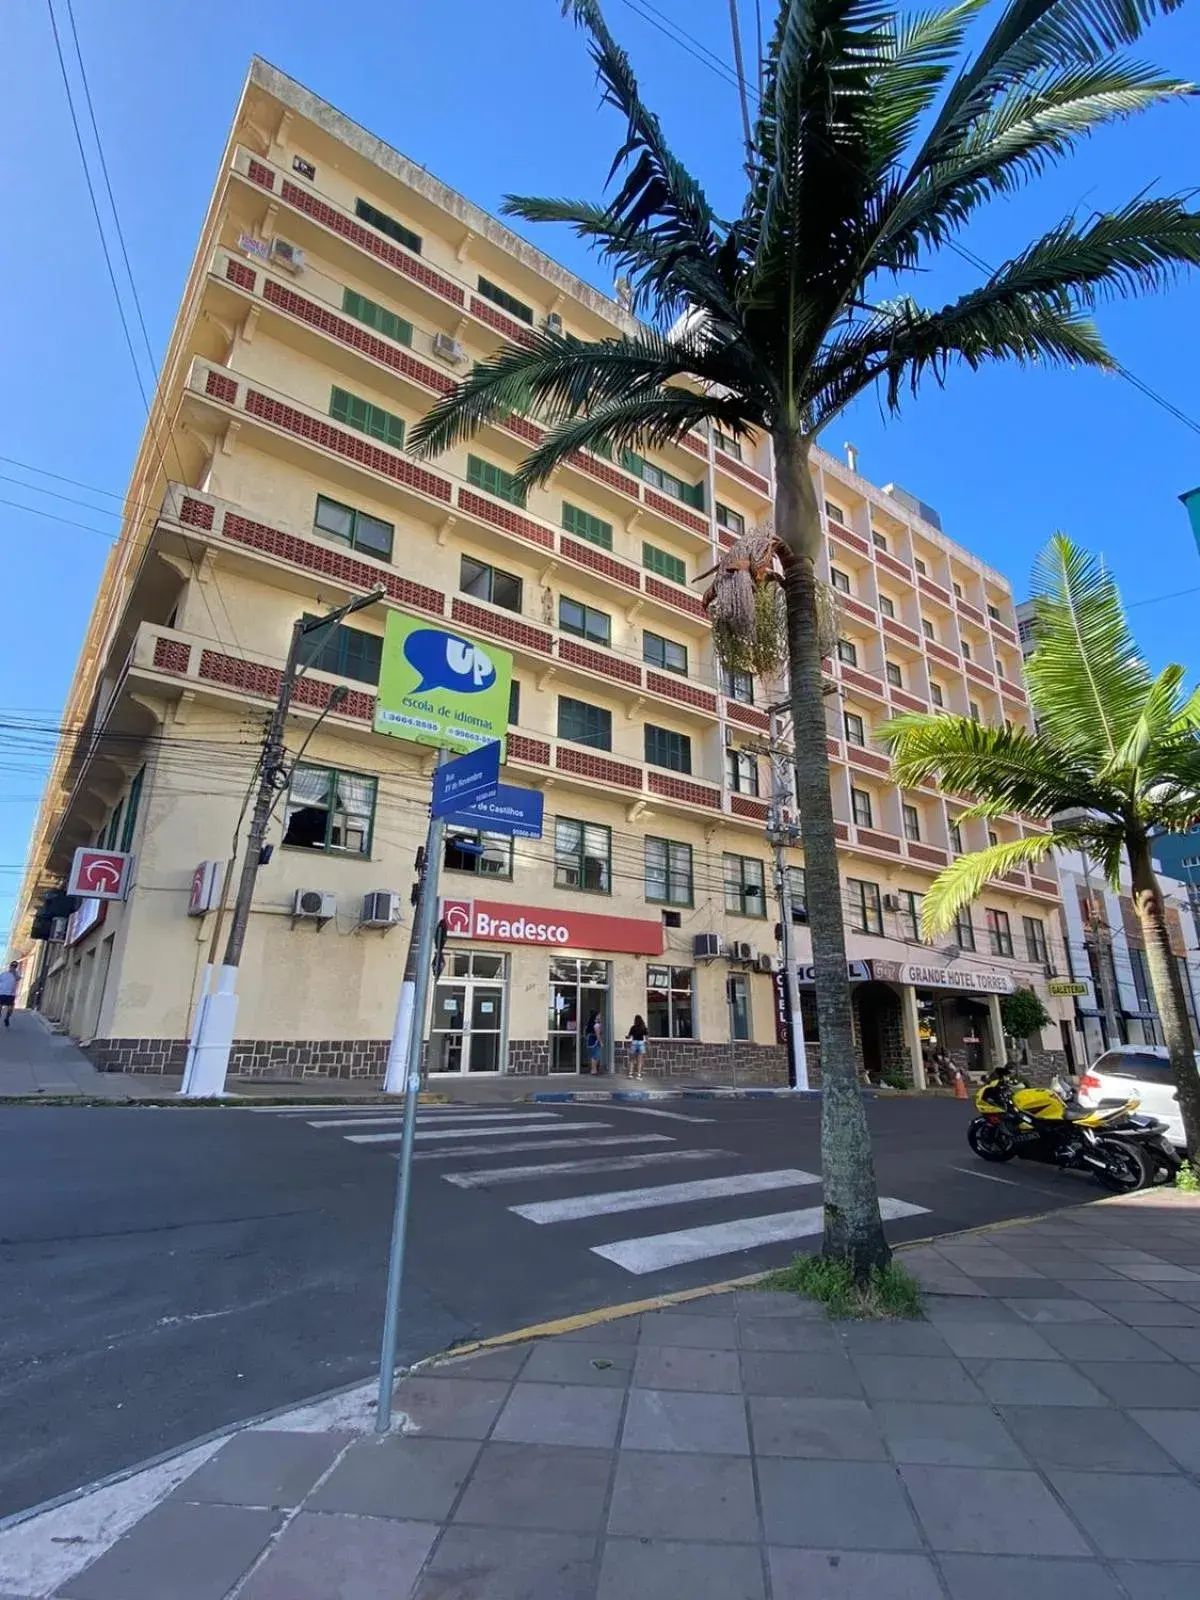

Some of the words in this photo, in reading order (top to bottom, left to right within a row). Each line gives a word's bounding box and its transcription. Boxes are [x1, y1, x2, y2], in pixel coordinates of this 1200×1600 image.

[402, 697, 433, 713] escola
[438, 706, 451, 718] de
[454, 711, 493, 730] idiomas
[478, 802, 487, 811] de
[489, 804, 524, 817] Castilhos
[476, 913, 569, 943] Bradesco
[908, 966, 946, 984] GRANDE
[947, 969, 975, 987] HOTEL
[976, 975, 1008, 991] TORRES
[1052, 984, 1086, 995] GALETERIA
